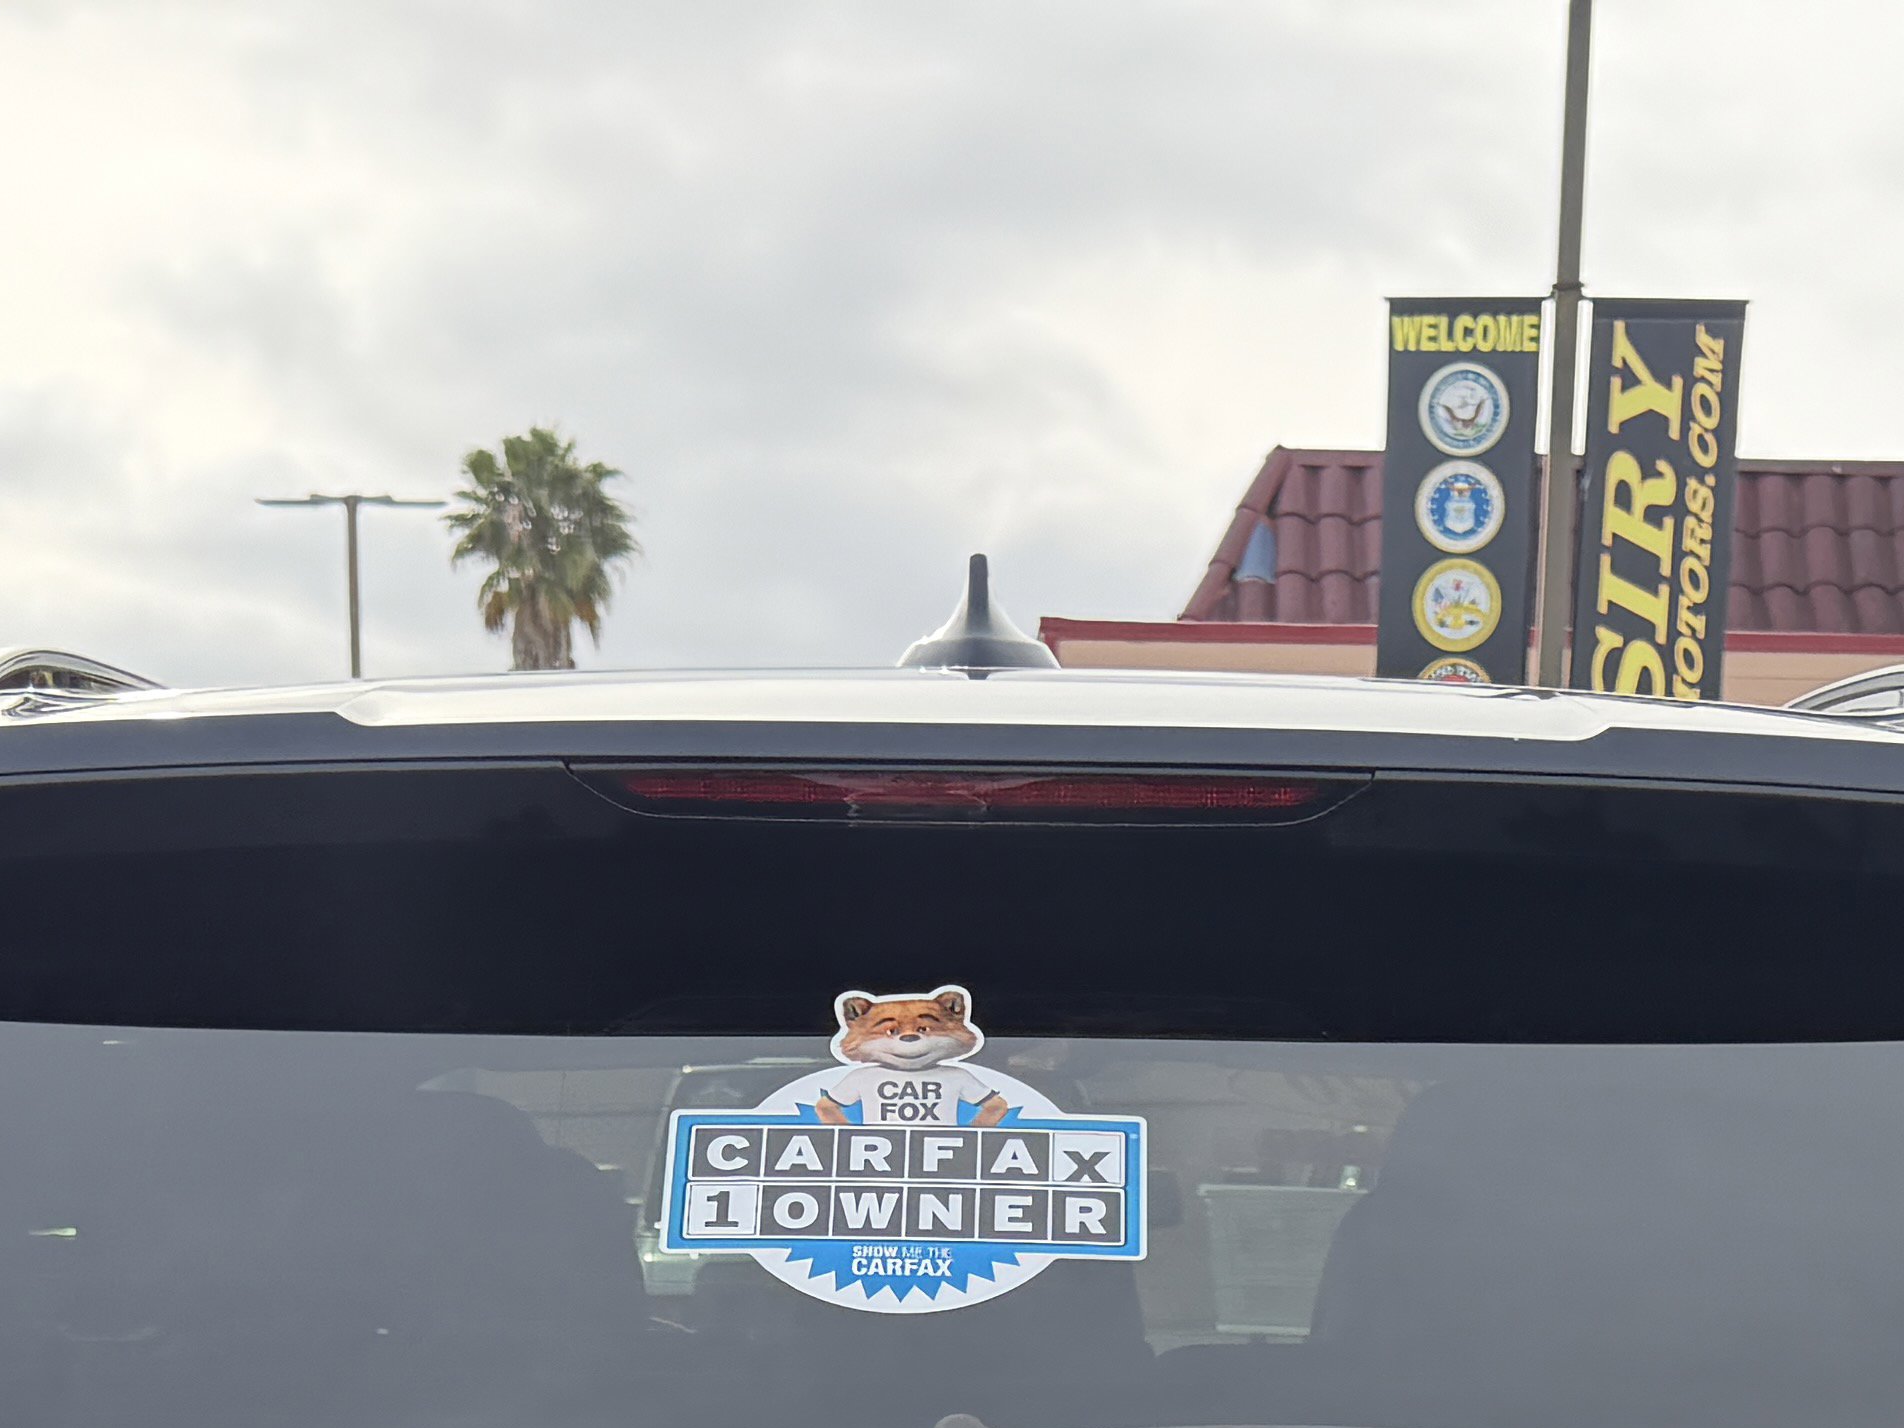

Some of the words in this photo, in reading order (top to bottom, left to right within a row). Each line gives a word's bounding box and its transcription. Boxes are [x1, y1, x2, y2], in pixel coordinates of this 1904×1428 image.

[1391, 313, 1540, 353] WELCOME
[1591, 320, 1683, 697] SIRY
[877, 1081, 942, 1100] CAR
[880, 1103, 941, 1121] FOX
[706, 1135, 1111, 1183] CARFAX
[704, 1190, 740, 1228] 1
[773, 1192, 1107, 1235] OWNER
[851, 1258, 953, 1276] CARFAX
[852, 1245, 898, 1257] SHOW
[902, 1246, 922, 1259] ME
[927, 1247, 952, 1260] THE
